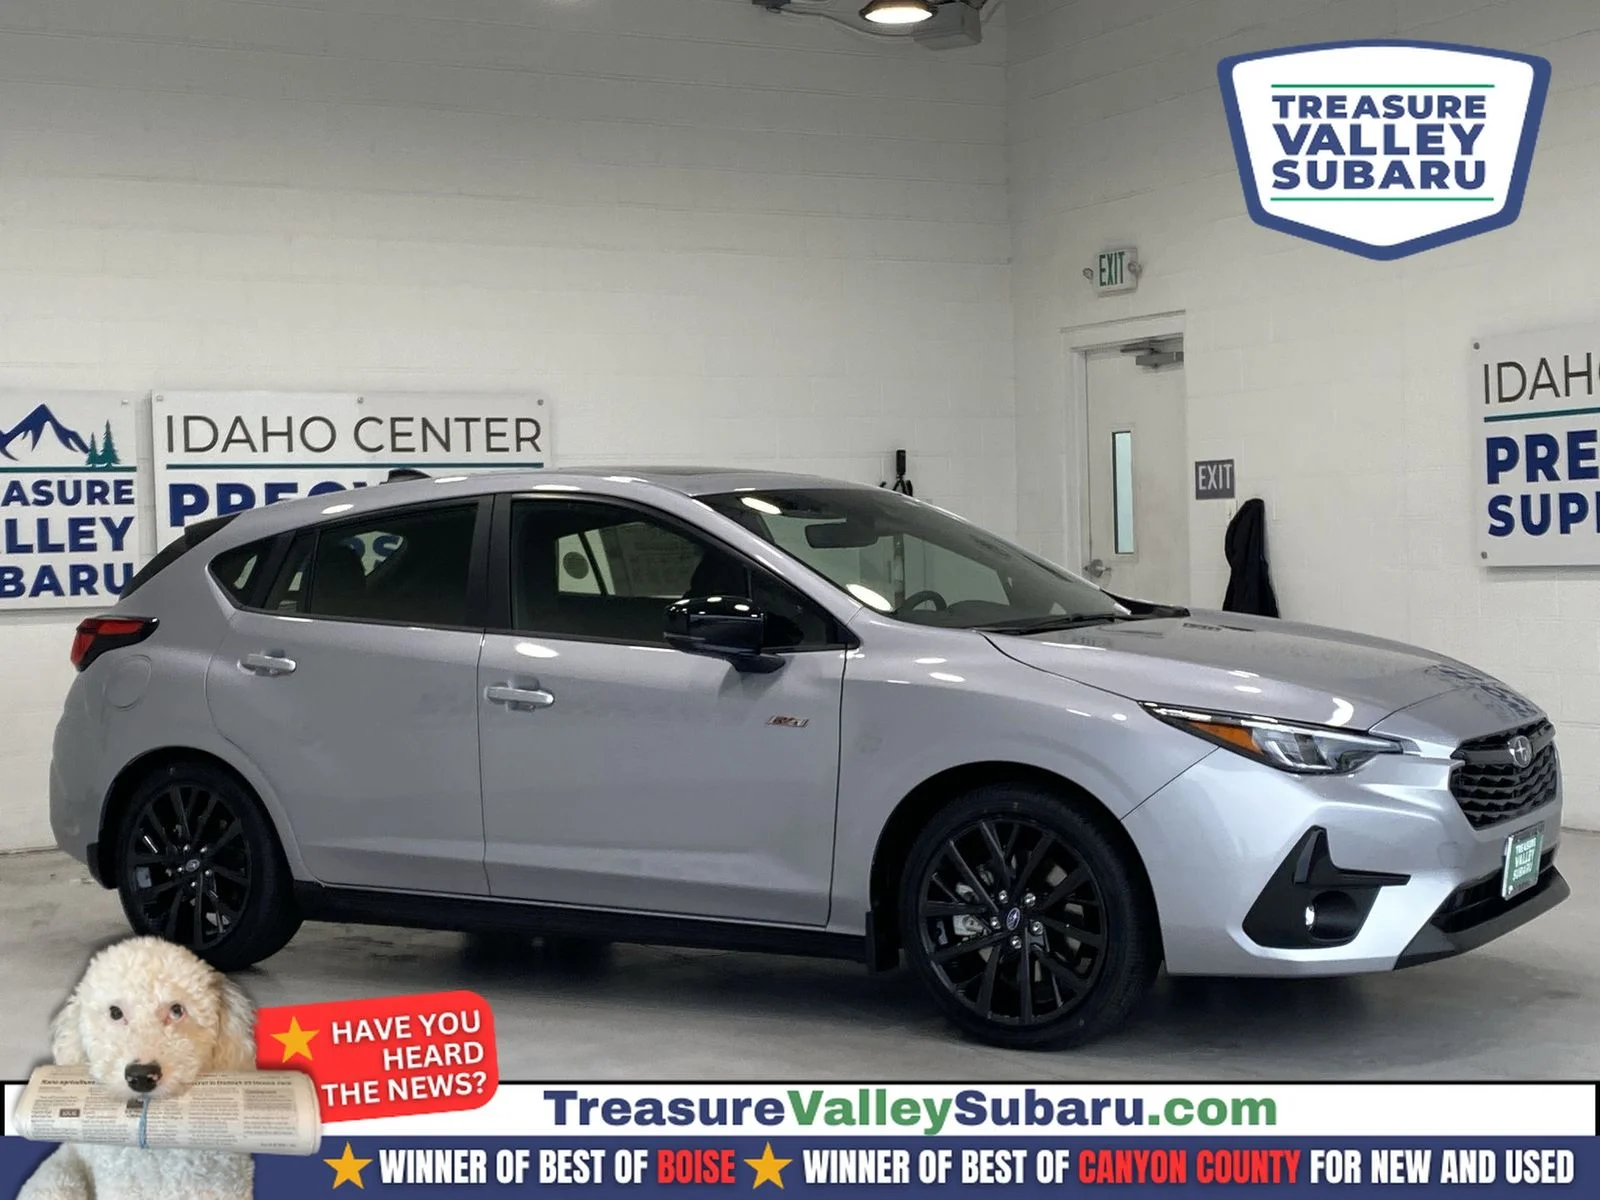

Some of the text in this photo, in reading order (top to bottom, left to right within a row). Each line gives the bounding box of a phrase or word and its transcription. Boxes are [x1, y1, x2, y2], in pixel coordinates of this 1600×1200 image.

[1099, 251, 1125, 287] EXIT
[1483, 352, 1600, 405] IDAH
[166, 414, 542, 453] IDAHO CENTER
[1198, 463, 1232, 490] EXIT
[1485, 429, 1600, 485] PRE
